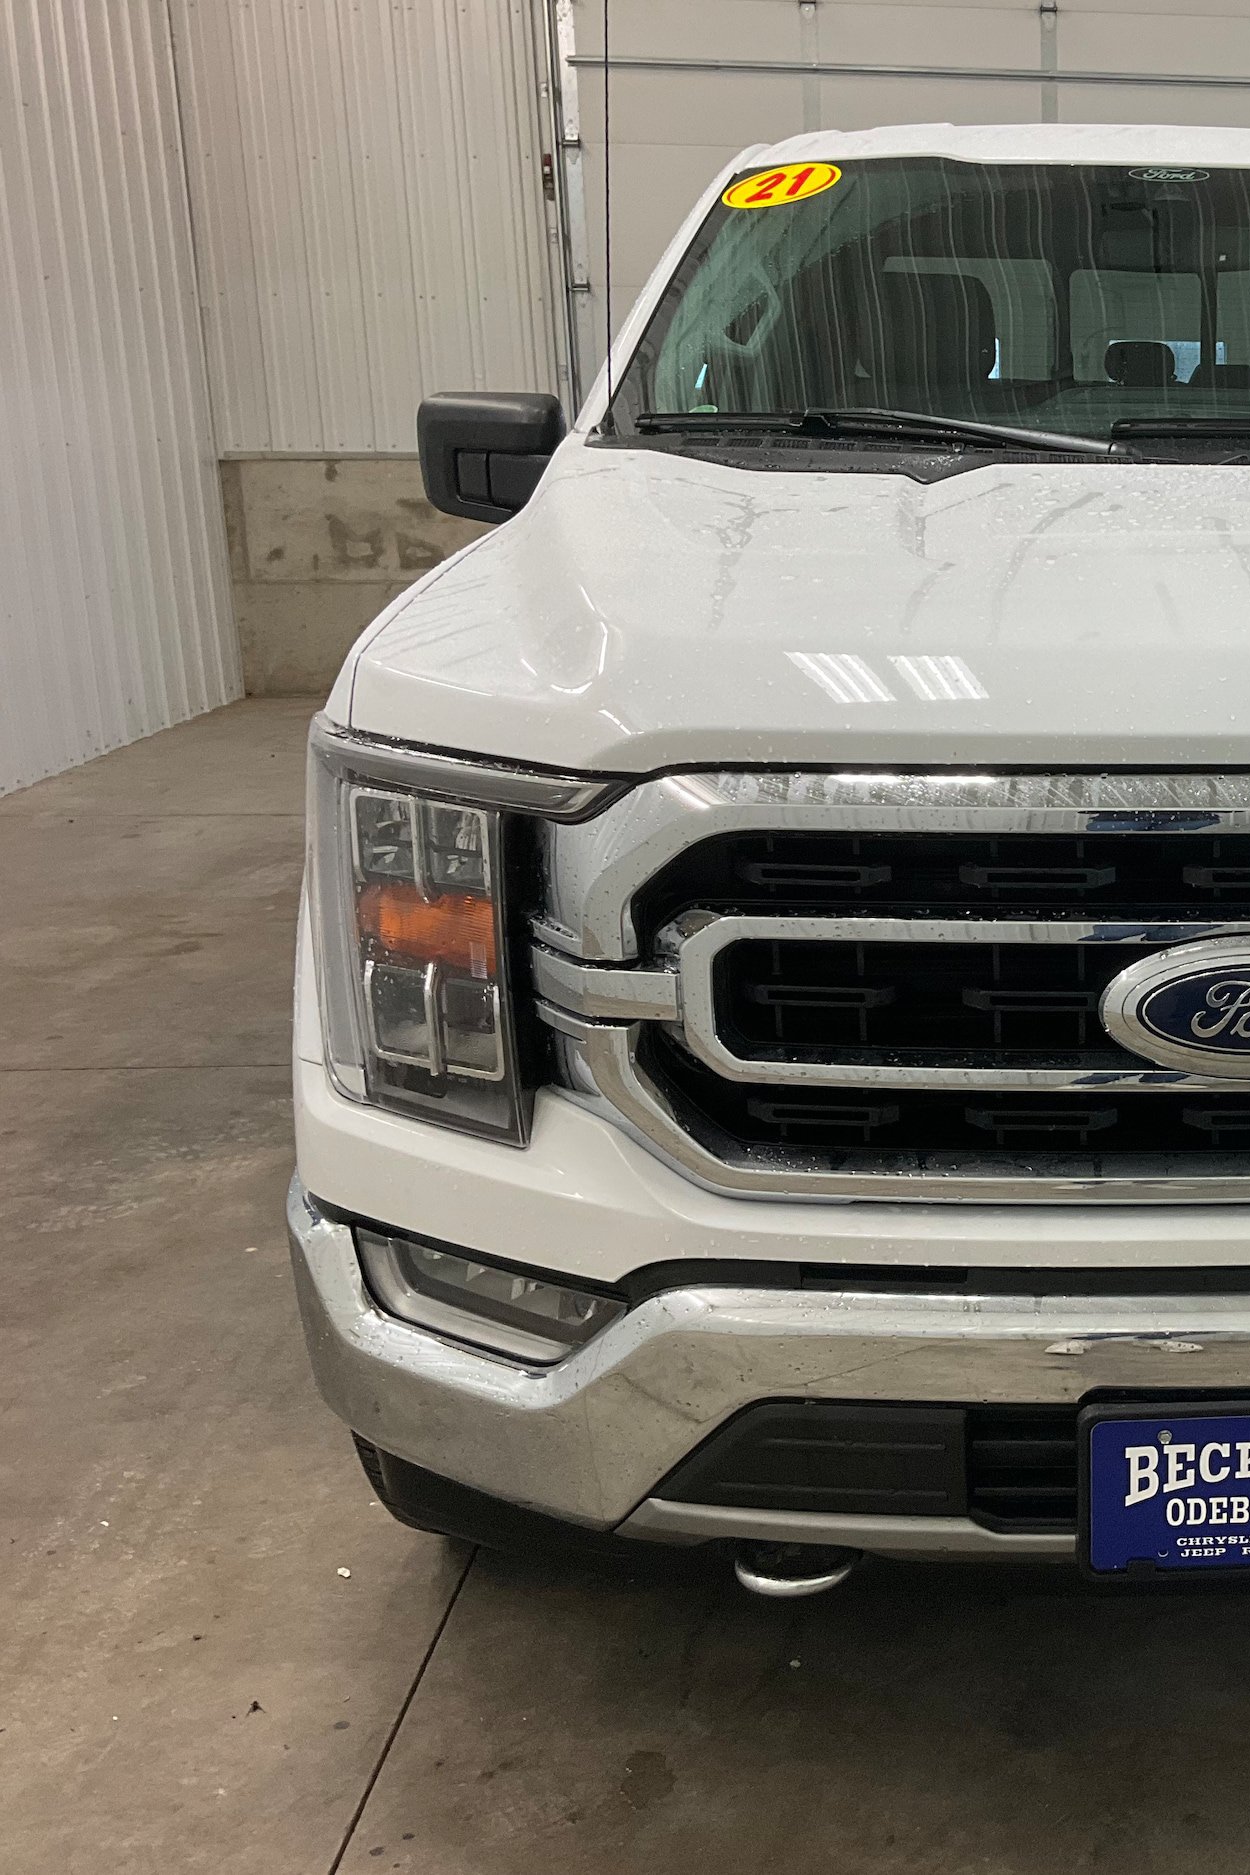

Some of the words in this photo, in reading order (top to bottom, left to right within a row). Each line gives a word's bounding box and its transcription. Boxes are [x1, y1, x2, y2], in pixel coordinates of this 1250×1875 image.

[1142, 168, 1196, 180] Ford
[744, 167, 816, 203] 21
[1180, 1546, 1227, 1557] JEEP
